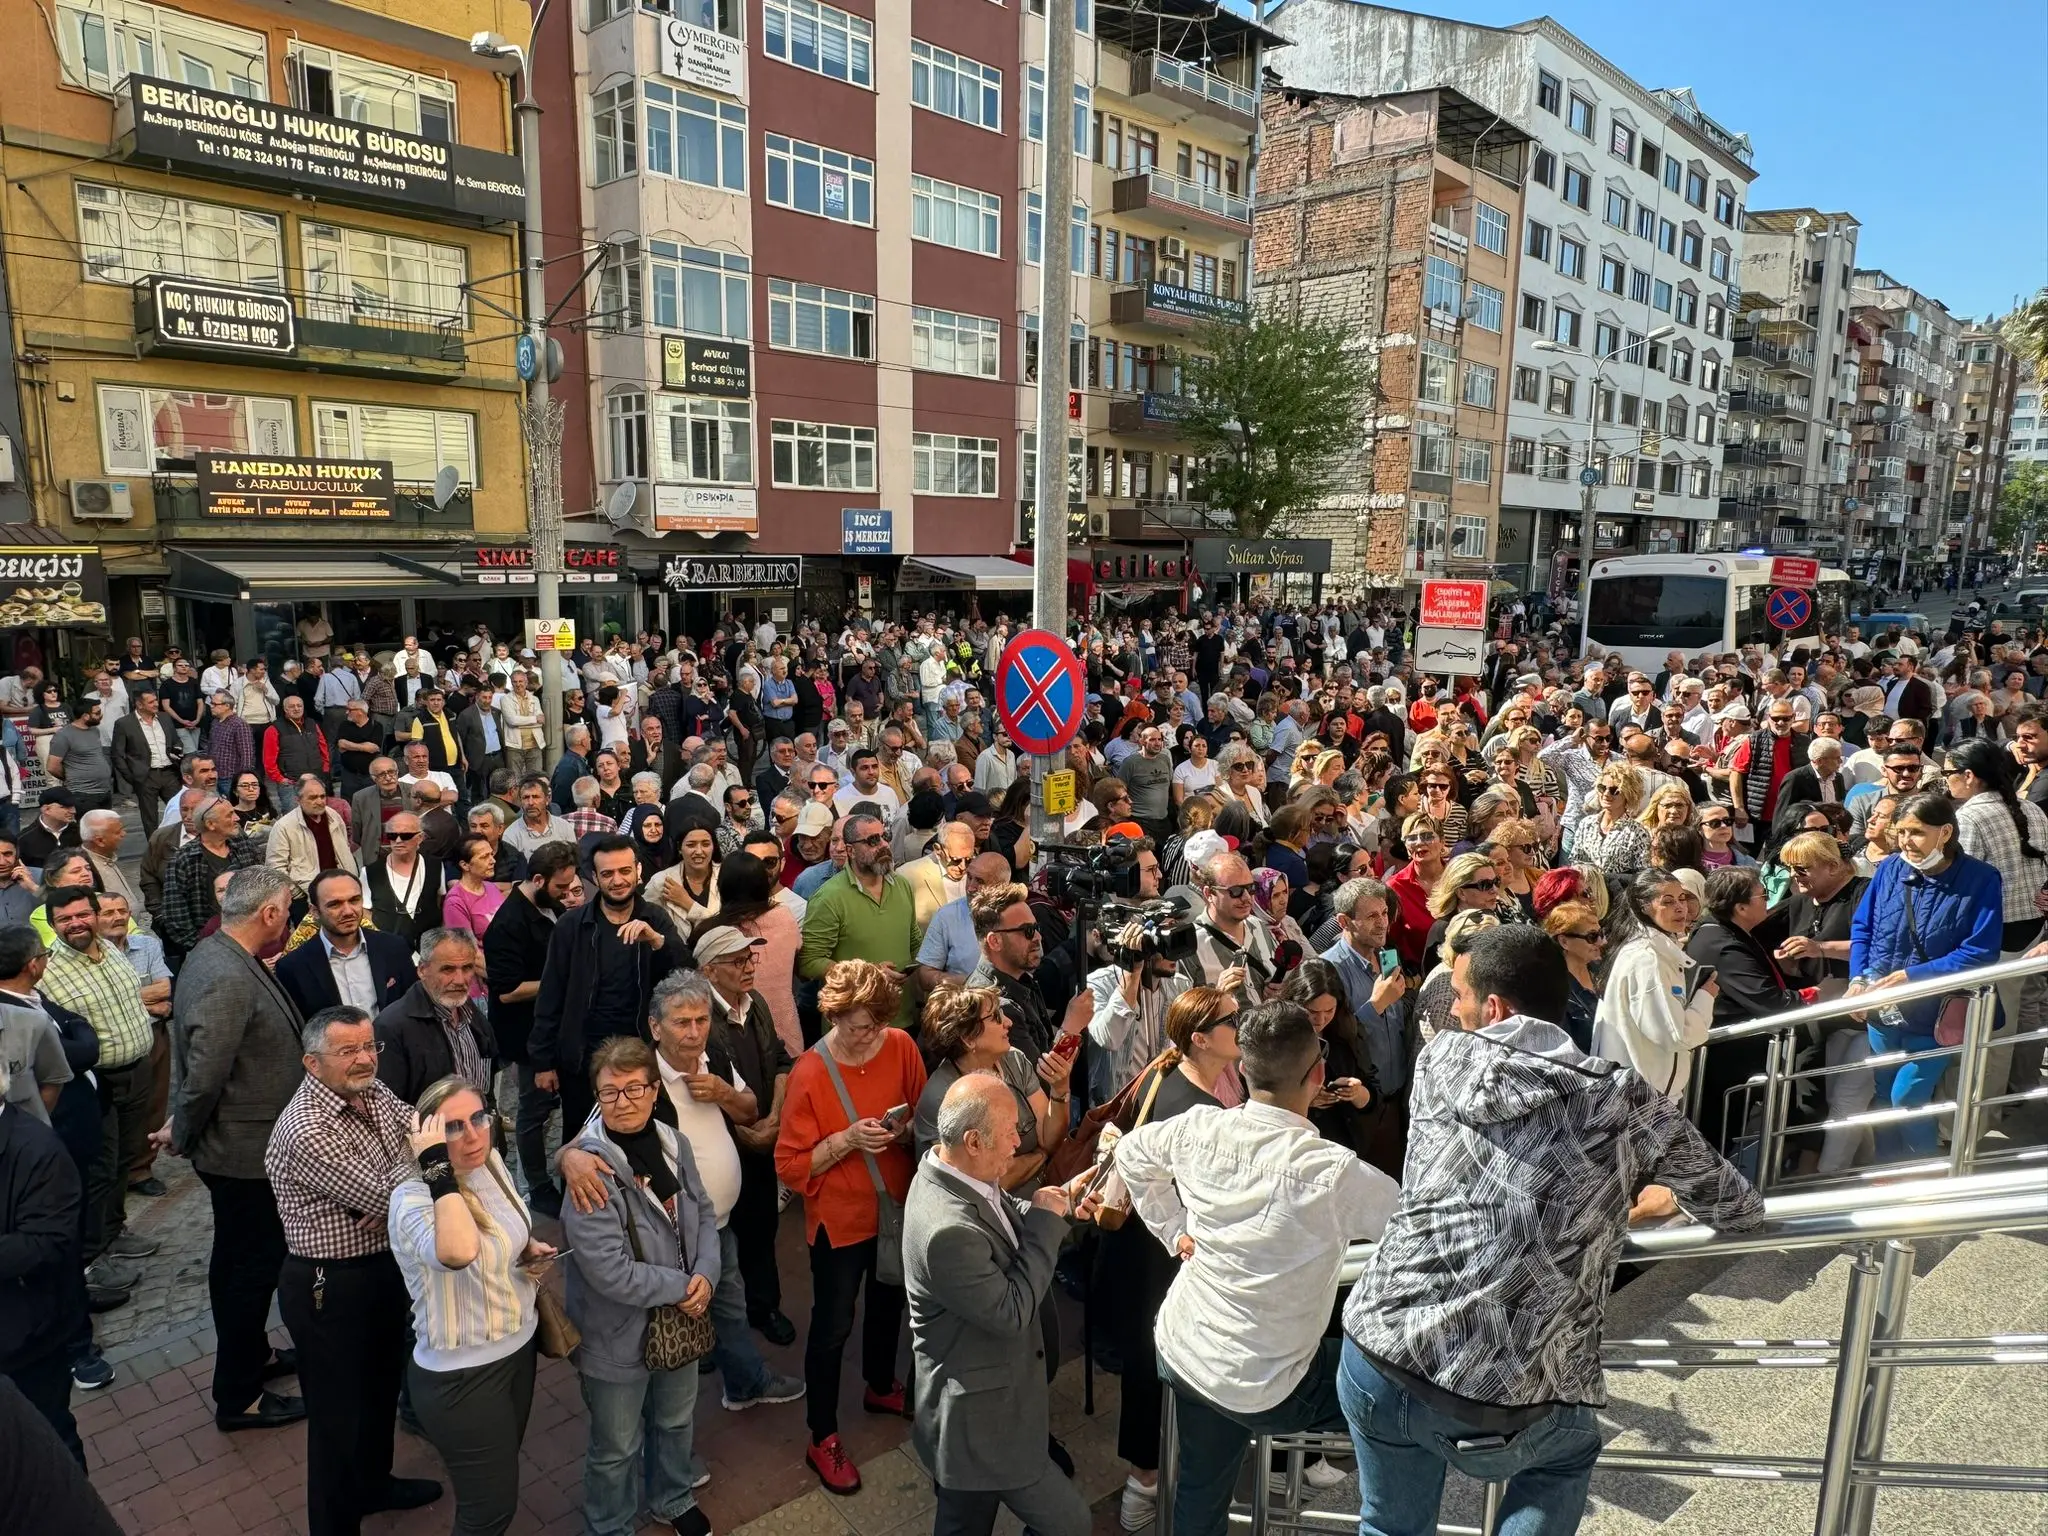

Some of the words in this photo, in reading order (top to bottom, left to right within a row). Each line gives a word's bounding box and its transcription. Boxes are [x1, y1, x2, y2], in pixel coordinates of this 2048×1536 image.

[141, 84, 277, 130] BEKİROĞLU
[283, 114, 361, 148] HUKUK
[366, 131, 446, 165] BÜROSU
[143, 110, 183, 130] Av.Serap
[185, 118, 237, 139] BEKİROĞLU
[239, 127, 263, 145] KÖSE
[269, 136, 307, 154] Av.Doğan
[308, 145, 355, 163] BEKİROĞLU
[404, 163, 447, 181] BEKİROĞLU
[196, 140, 214, 155] Tel
[222, 145, 230, 157] 0
[231, 146, 252, 161] 262
[254, 150, 273, 165] 324
[275, 154, 287, 168] 91
[291, 156, 303, 171] 78
[308, 160, 325, 176] Fax
[333, 165, 340, 178] 0
[342, 167, 360, 181] 262
[361, 170, 379, 185] 324
[381, 174, 391, 188] 91
[394, 177, 405, 190] 79
[1153, 283, 1188, 300] KONYALI
[165, 291, 191, 313] KOÇ
[194, 294, 235, 317] HUKUK
[238, 298, 285, 323] BÜROSU
[177, 317, 200, 336] Av.
[202, 317, 248, 342] ÖZDEN
[251, 326, 279, 347] KOÇ
[703, 349, 730, 360] AVUKAT
[211, 460, 313, 478] HANEDAN
[316, 465, 383, 480] HUKUK
[236, 478, 245, 489] &
[249, 479, 364, 493] ARABULUCULUK
[854, 512, 882, 527] İNCİ
[844, 529, 854, 546] İŞ
[855, 527, 891, 543] MERKEZİ
[567, 549, 619, 568] CAFE
[1226, 544, 1265, 566] Sultan
[1267, 545, 1304, 570] Sofrası
